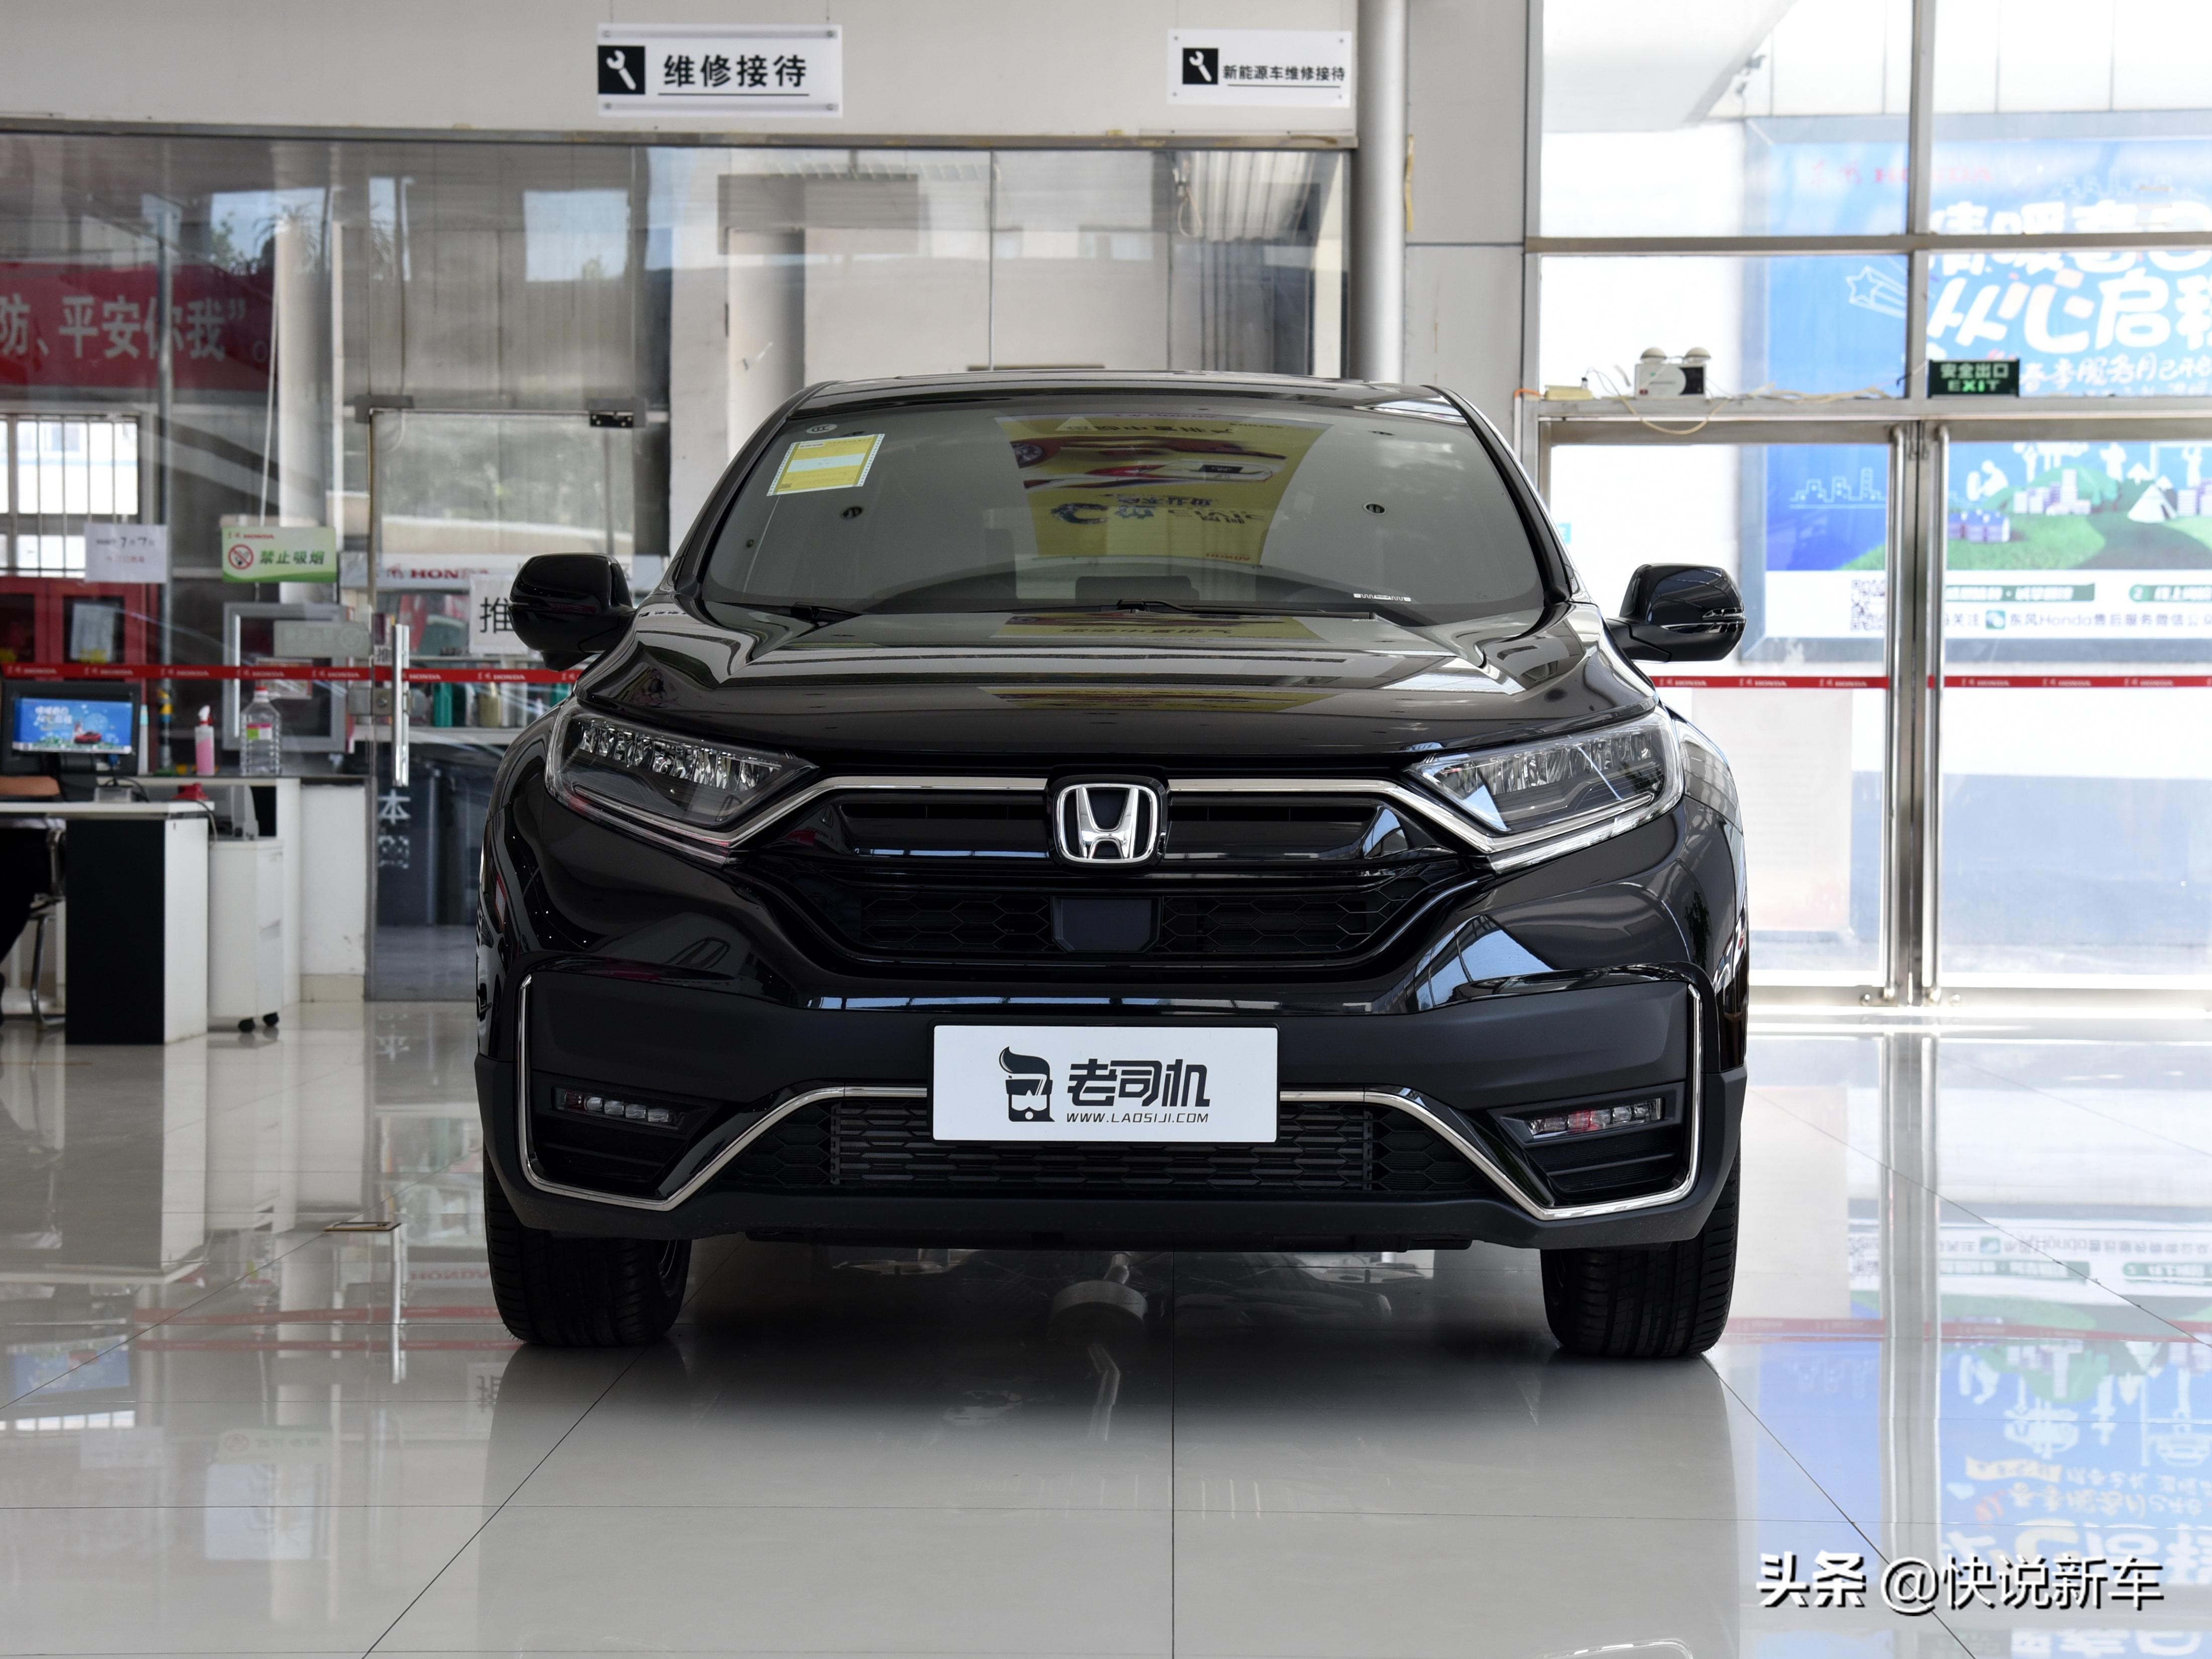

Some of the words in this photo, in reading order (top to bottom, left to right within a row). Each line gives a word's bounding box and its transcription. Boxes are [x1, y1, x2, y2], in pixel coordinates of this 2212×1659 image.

[663, 54, 806, 88] 维修接待
[1223, 65, 1346, 81] 新能源车维修接待
[1940, 363, 2009, 379] 安全出口
[1947, 379, 2000, 392] EXIT
[260, 549, 325, 565] 禁止吸烟
[1067, 1058, 1211, 1107] 老司机
[1066, 1113, 1209, 1123] WWW.LAOSIJI.COM
